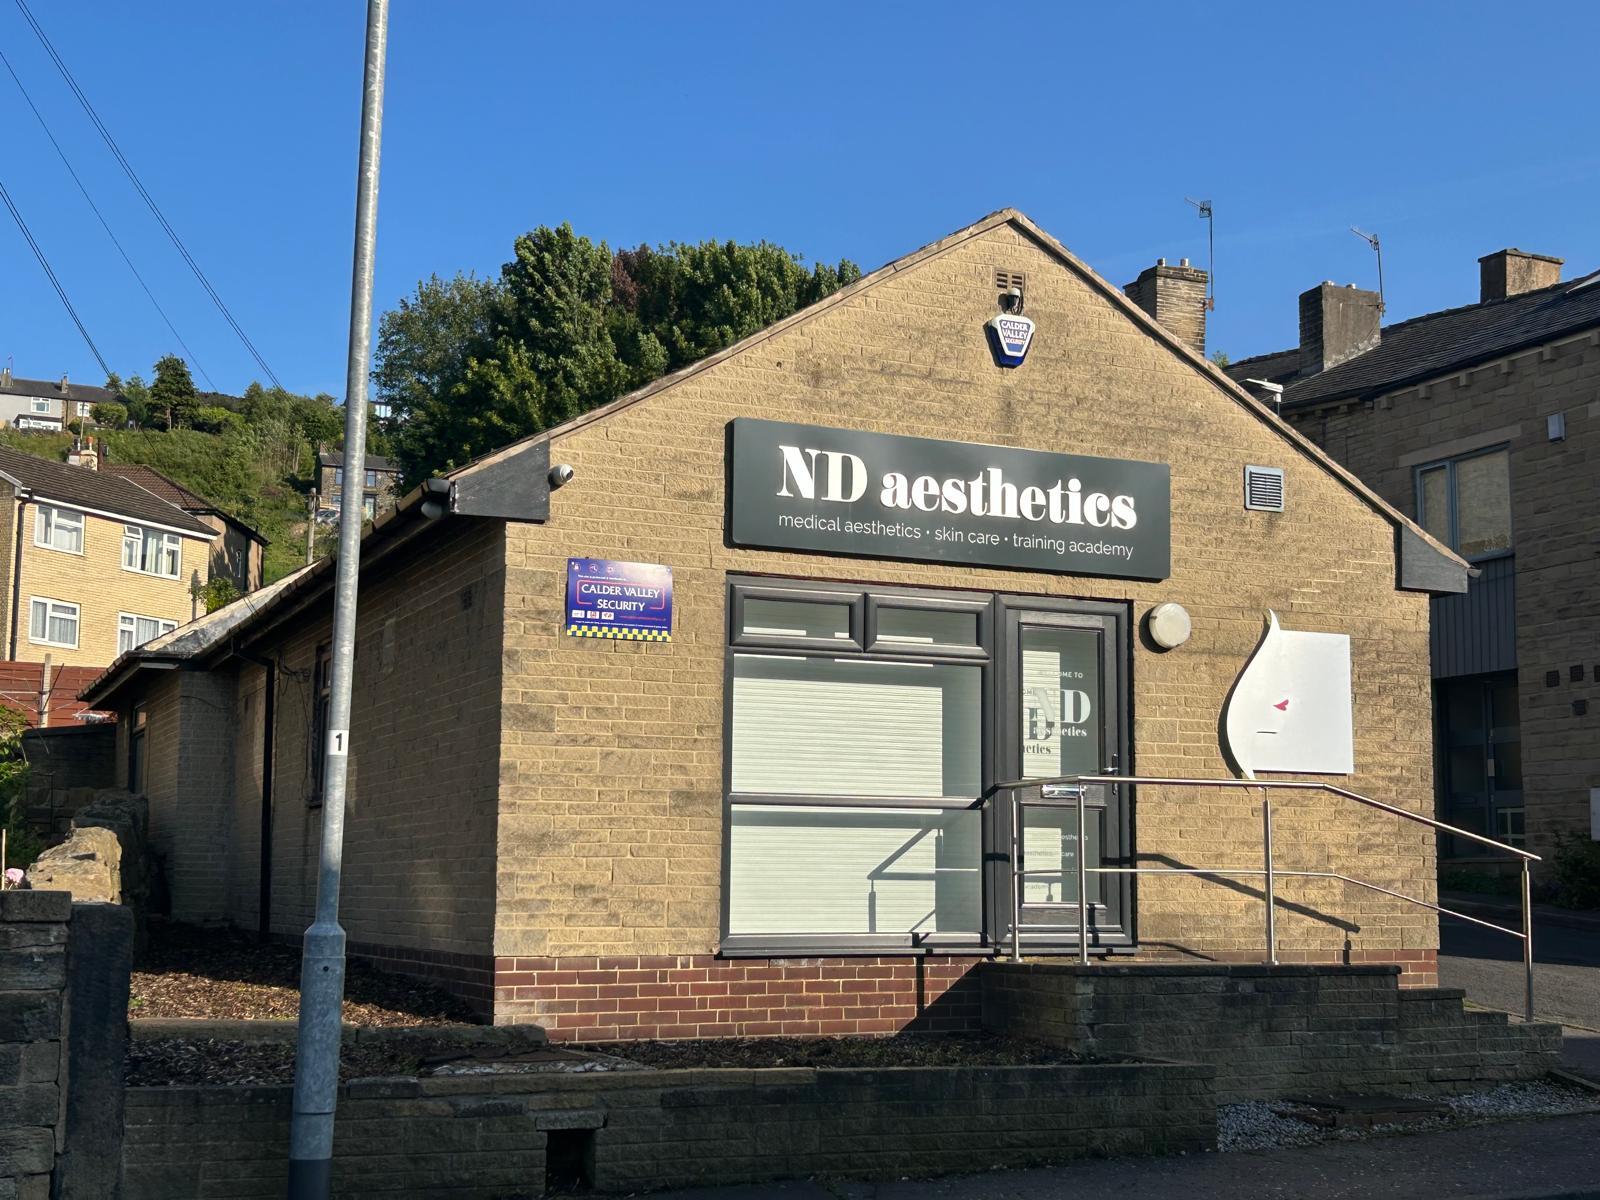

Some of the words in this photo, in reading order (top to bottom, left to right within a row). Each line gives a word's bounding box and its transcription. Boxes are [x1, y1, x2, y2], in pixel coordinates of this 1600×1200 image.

[1001, 321, 1028, 331] CALDER
[1003, 329, 1027, 339] VALLEY
[776, 445, 868, 503] ND
[880, 467, 1138, 530] aesthetics
[778, 514, 841, 532] medical
[844, 520, 922, 539] aesthetics
[935, 526, 964, 542] skin
[967, 532, 1000, 546] care
[1012, 533, 1065, 554] training
[1068, 540, 1134, 561] academy
[581, 584, 622, 596] CALDER
[623, 587, 660, 598] VALLEY
[597, 599, 645, 611] SECURITY
[335, 732, 342, 751] 1
